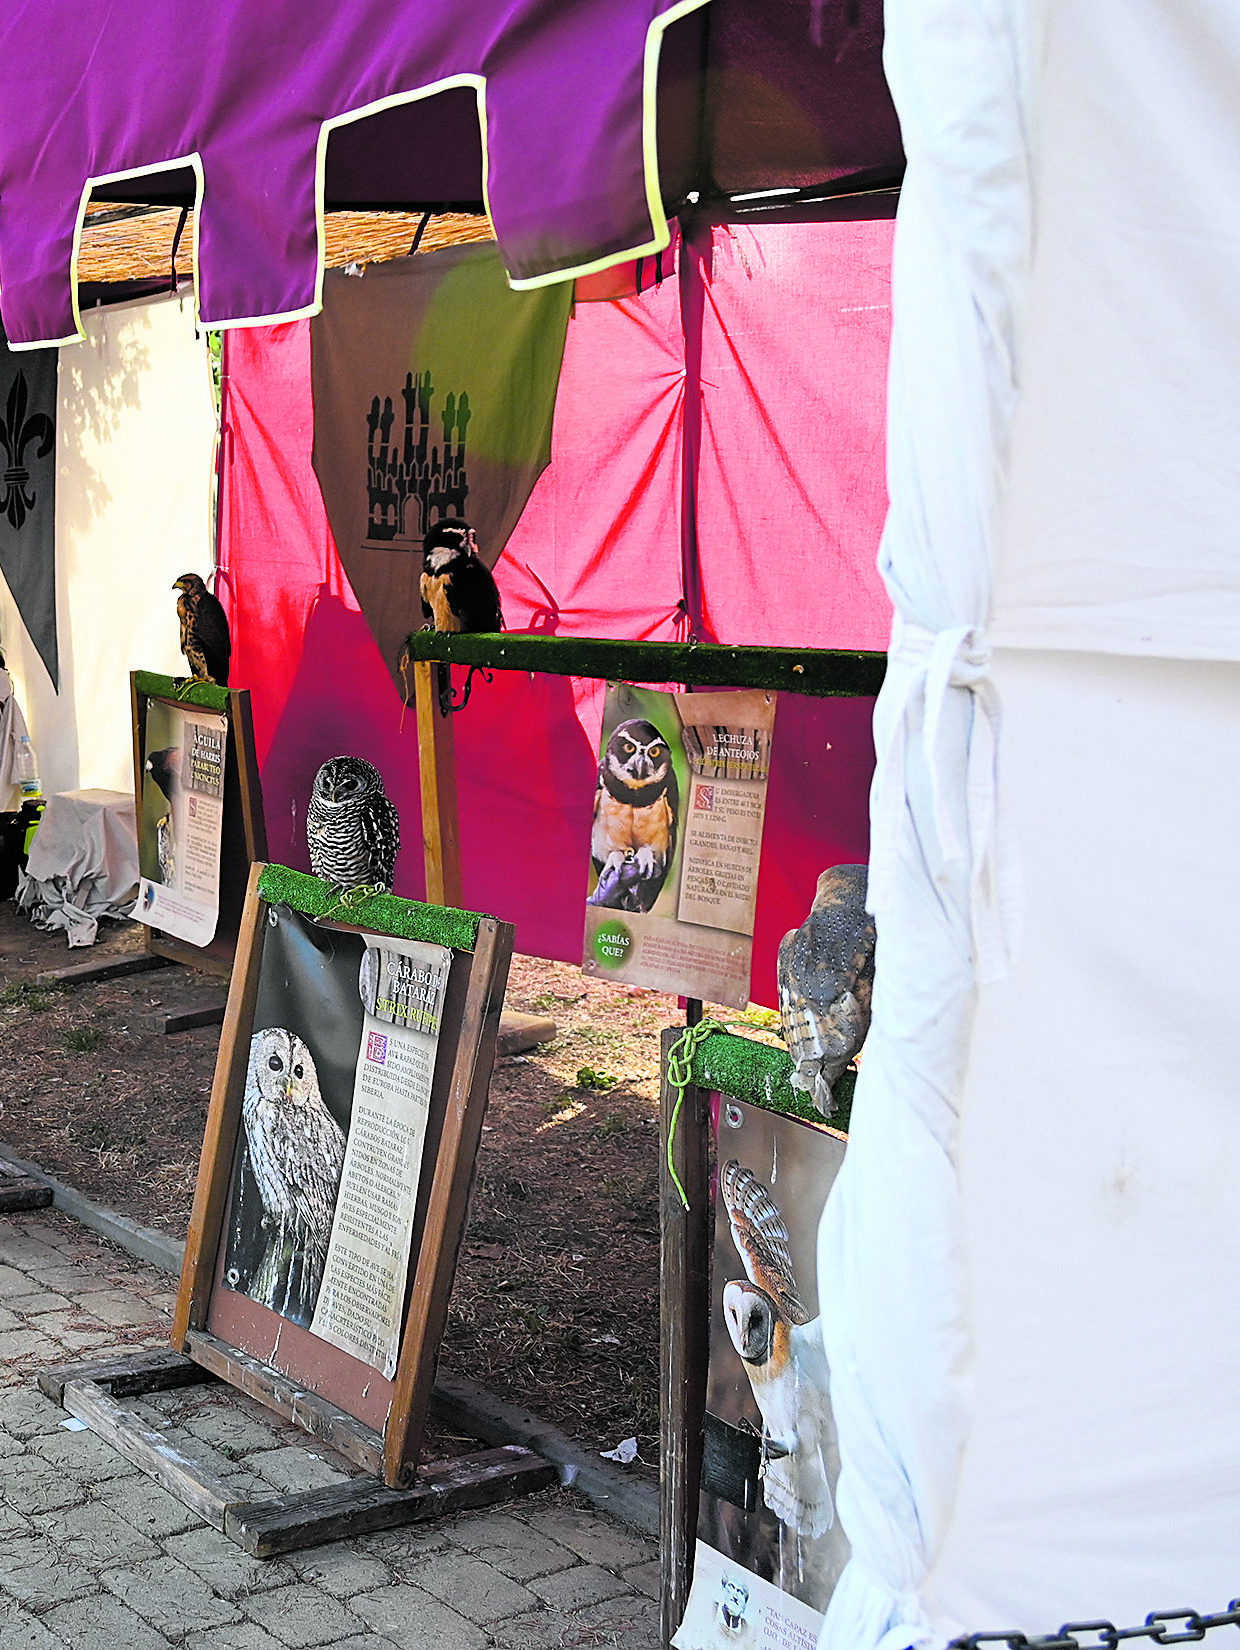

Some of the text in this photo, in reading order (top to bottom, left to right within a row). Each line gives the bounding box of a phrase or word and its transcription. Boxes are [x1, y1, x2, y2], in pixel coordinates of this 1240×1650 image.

[193, 730, 220, 750] ÁGUILA
[713, 734, 753, 745] LECHUZA
[192, 748, 221, 764] DE HARRIS
[706, 746, 759, 760] DE ANTEOJOS
[699, 831, 727, 841] ALIMENTA
[720, 843, 737, 852] RANAS
[689, 857, 714, 867] NIDIFICA
[724, 862, 746, 872] HUECOS
[746, 865, 752, 874] DE
[685, 892, 696, 900] DEL
[597, 933, 630, 946] ¿SABÍAS
[602, 946, 624, 958] QUE?
[387, 960, 441, 990] CÁRABO DE
[393, 980, 436, 1006] BATARÁZ
[376, 998, 409, 1018] STRIX
[394, 1041, 406, 1050] UNA
[387, 1060, 401, 1071] SIDO
[388, 1049, 399, 1058] AVE
[400, 1054, 415, 1065] RAPAZ
[364, 1063, 400, 1082] DISTRIBUIDA
[363, 1074, 372, 1083] DE
[373, 1078, 394, 1091] EUROPA
[395, 1086, 409, 1097] HASTA
[359, 1106, 415, 1136] DURANTE LA ÉPOCA DE
[355, 1126, 380, 1143] CÁRABOS
[352, 1149, 402, 1177] NIDOS EN ZONAS DE
[348, 1170, 369, 1185] ABETOS
[369, 1179, 374, 1187] O
[376, 1171, 412, 1195] NORMALMENTE
[346, 1181, 398, 1211] SUELEN USAR RAMAS
[342, 1202, 397, 1234] AVES ESPECIALMENTE
[369, 1203, 388, 1217] MUSGO
[340, 1212, 375, 1234] RESISTENTES
[380, 1231, 389, 1241] LAS
[338, 1222, 381, 1249] ENFERMEDADES
[385, 1245, 391, 1255] AL
[335, 1244, 394, 1280] ESTE TIPO DE AVE SE HA
[330, 1265, 340, 1275] LAS
[341, 1271, 366, 1288] ESPECIES
[366, 1282, 378, 1295] MÁS
[332, 1255, 368, 1278] CONVERTIDO
[369, 1272, 376, 1282] EN
[388, 1283, 395, 1293] DE
[328, 1276, 387, 1312] MENTE ENCONTRADAS
[340, 1293, 351, 1304] LOS
[352, 1300, 391, 1327] OBSERVADORES
[347, 1309, 364, 1323] DADO
[364, 1318, 372, 1327] SU
[333, 1325, 360, 1345] COLORES
[765, 1616, 787, 1635] COSAS
[784, 1617, 818, 1644] CAPAZ ES
